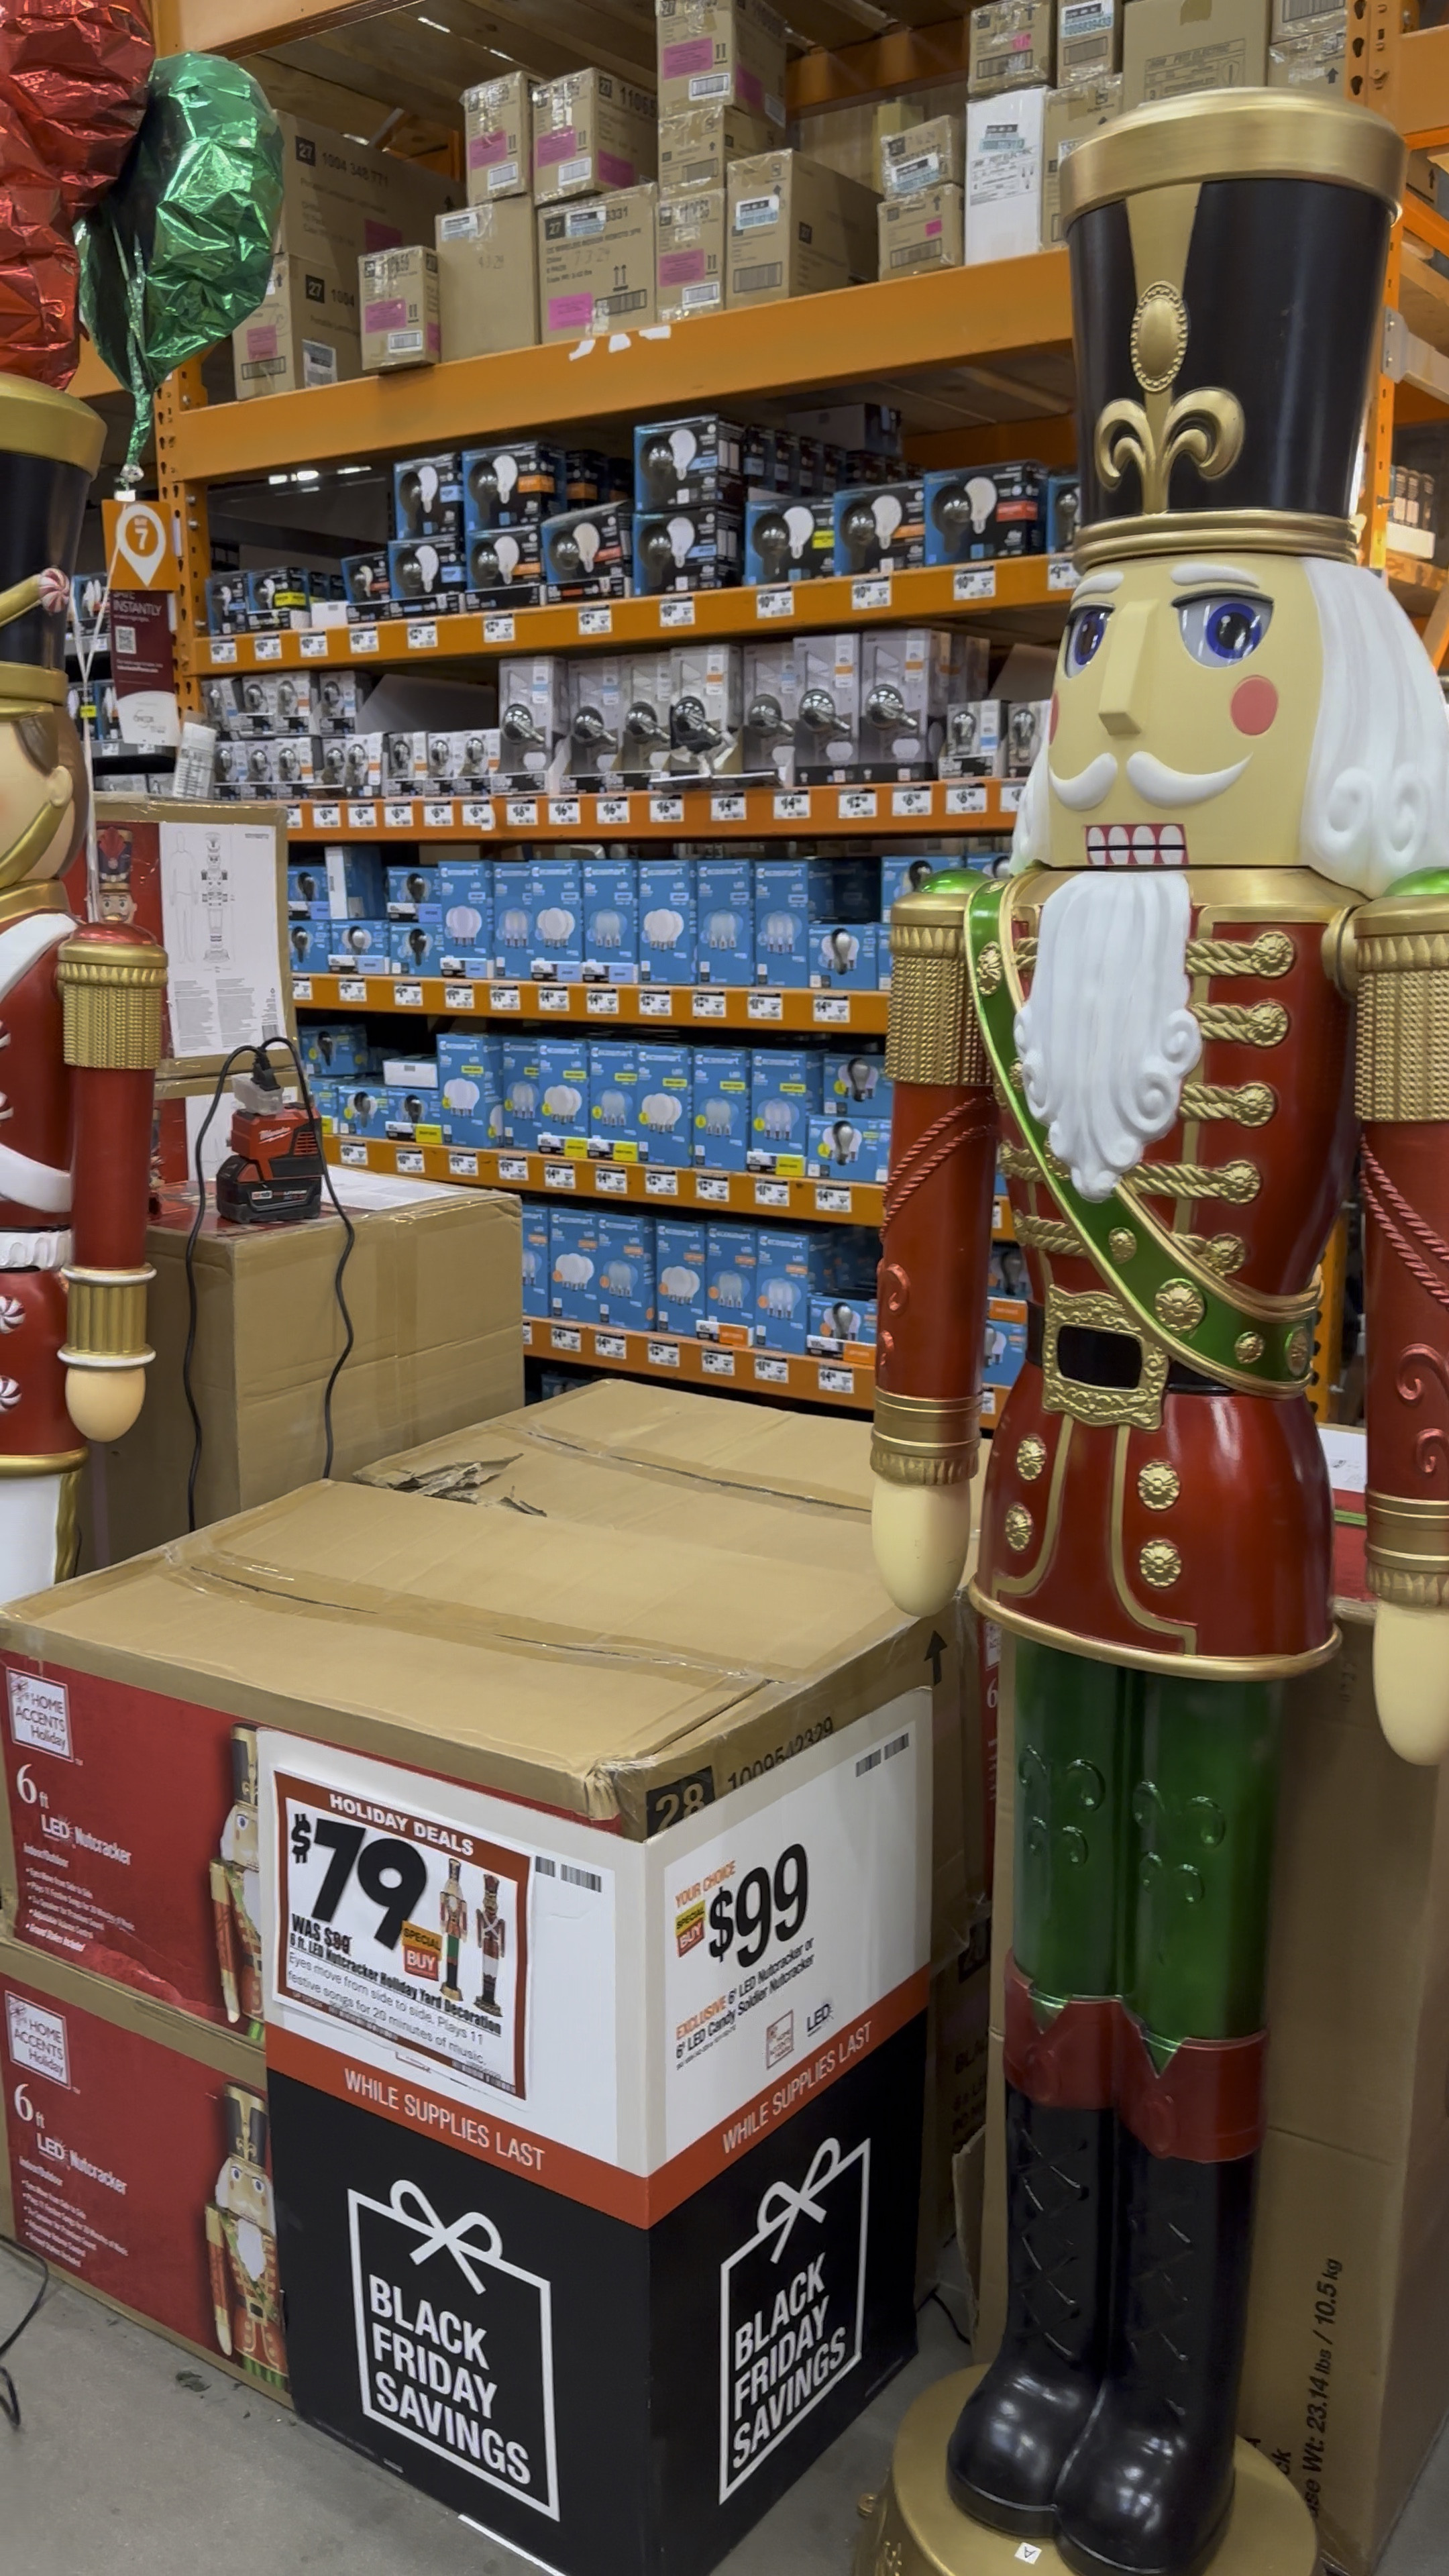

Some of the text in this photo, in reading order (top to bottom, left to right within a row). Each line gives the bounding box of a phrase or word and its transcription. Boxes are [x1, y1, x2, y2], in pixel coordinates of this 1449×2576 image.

[299, 143, 313, 160] 27
[307, 281, 322, 298] 27
[135, 528, 148, 550] 7
[15, 1706, 65, 1732] ACCENTS
[33, 1694, 64, 1715] HOME
[31, 1725, 66, 1751] Holiday
[17, 1763, 37, 1803] 6
[41, 1814, 70, 1839] LED
[329, 1793, 474, 1856] HOLIDAY DEALS
[655, 1783, 704, 1833] 28
[292, 1813, 427, 1950] $79
[675, 1882, 701, 1908] YOUR
[708, 1843, 808, 1968] $99
[292, 1913, 321, 1941] WAS
[403, 1928, 441, 1951] SPECIAL
[680, 1923, 702, 1949] BUY
[407, 1950, 435, 1971] BUY
[290, 1951, 312, 1971] Eyes
[314, 1964, 342, 1985] move
[344, 1976, 369, 1996] from
[371, 1990, 393, 2006] side
[396, 1999, 407, 2012] to
[438, 2016, 468, 2039] Plays
[471, 2031, 483, 2045] 11
[309, 1940, 323, 1958] LED
[419, 1988, 442, 2010] Yard
[445, 1998, 502, 2035] Decoration
[676, 1995, 727, 2040] EXCLUSIVE
[739, 1976, 756, 1998] LED
[757, 1945, 804, 1984] Nutcracker
[805, 1937, 814, 1951] or
[687, 2029, 705, 2051] LED
[708, 2009, 736, 2037] Candy
[738, 1987, 768, 2016] Soldier
[769, 1953, 814, 1994] Nutcracker
[288, 1970, 321, 1993] festive
[323, 1987, 355, 2008] songs
[356, 2000, 371, 2012] for
[389, 2015, 433, 2041] minutes
[435, 2035, 447, 2047] of
[806, 2002, 832, 2033] LED
[15, 2029, 64, 2061] ACCENTS
[29, 2022, 62, 2044] HOME
[29, 2047, 64, 2078] Holiday
[14, 2083, 34, 2122] 6
[722, 2021, 873, 2154] WHILE SUPPLIES LAST
[344, 2068, 545, 2171] WHILE SUPPLIES LAST
[36, 2132, 66, 2161] LED
[1322, 2258, 1342, 2282] kg
[368, 2274, 491, 2369] BLACK
[734, 2252, 826, 2369] BLACK
[1314, 2280, 1337, 2326] 10.5
[1312, 2329, 1334, 2347] /
[373, 2322, 498, 2419] FRIDAY
[733, 2295, 831, 2421] FRIDAY
[1314, 2348, 1332, 2375] lbs
[732, 2326, 847, 2469] SAVINGS
[1306, 2375, 1330, 2434] 23.14
[376, 2370, 531, 2486] SAVINGS
[1302, 2436, 1324, 2473] Wt:
